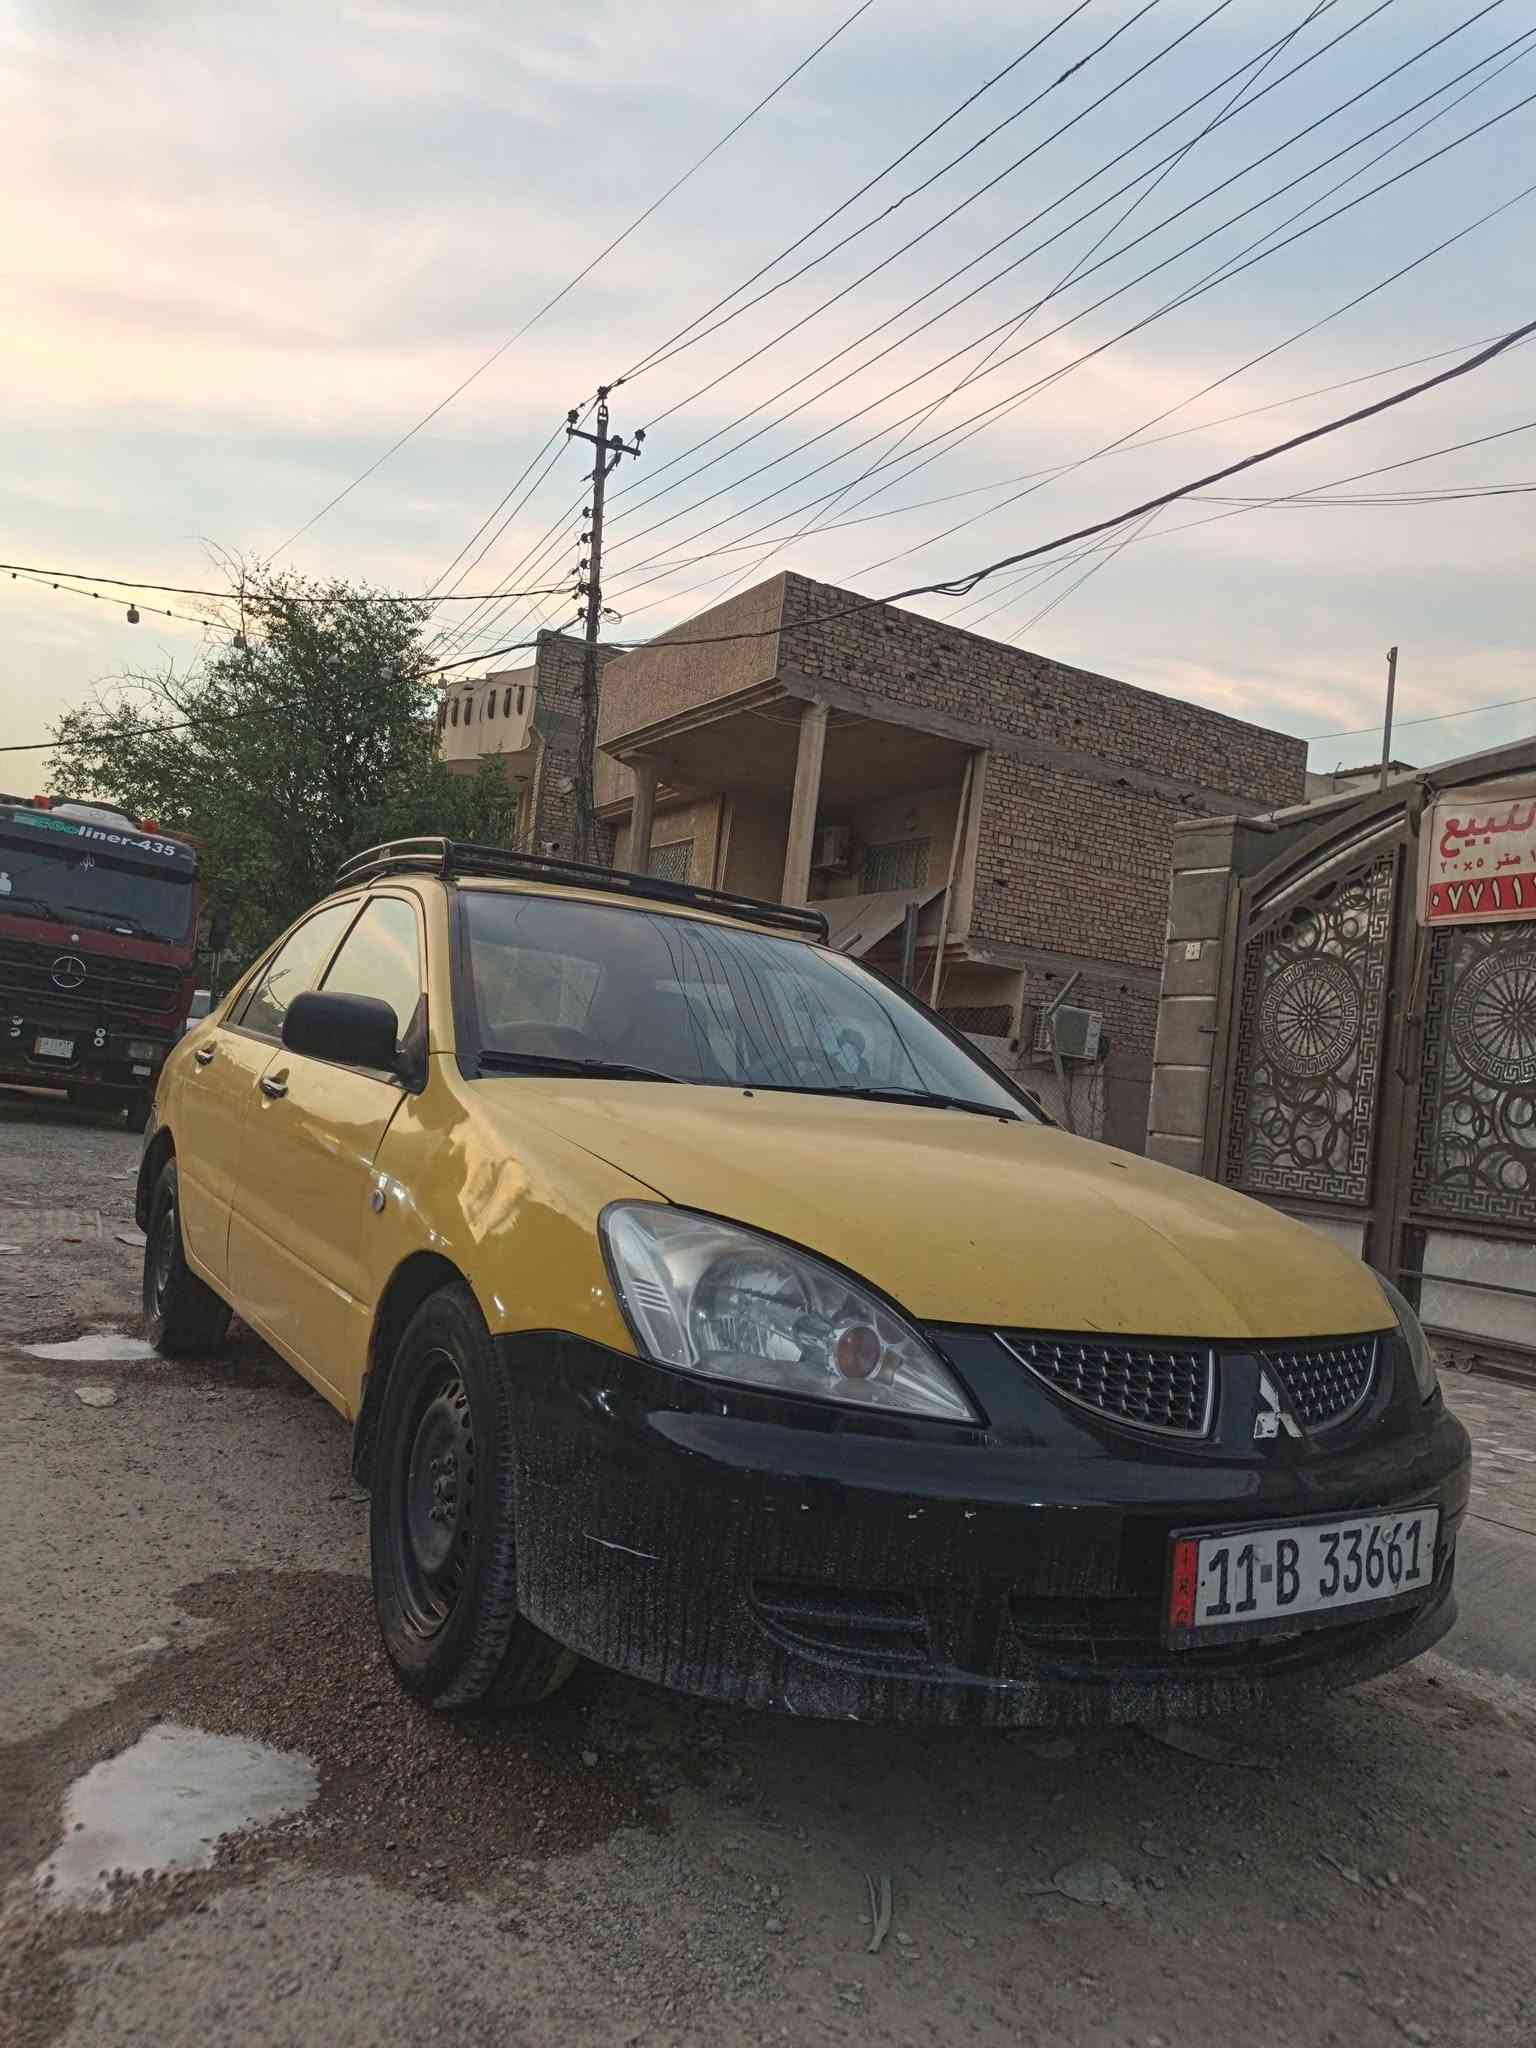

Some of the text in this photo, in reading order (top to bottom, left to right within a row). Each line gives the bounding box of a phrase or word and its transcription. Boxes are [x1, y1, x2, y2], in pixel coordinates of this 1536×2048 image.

[1440, 801, 1536, 858] للبيع
[1495, 853, 1521, 871] متر
[1432, 875, 1536, 912] ٠٧٧١١
[1319, 1520, 1422, 1598] 33661
